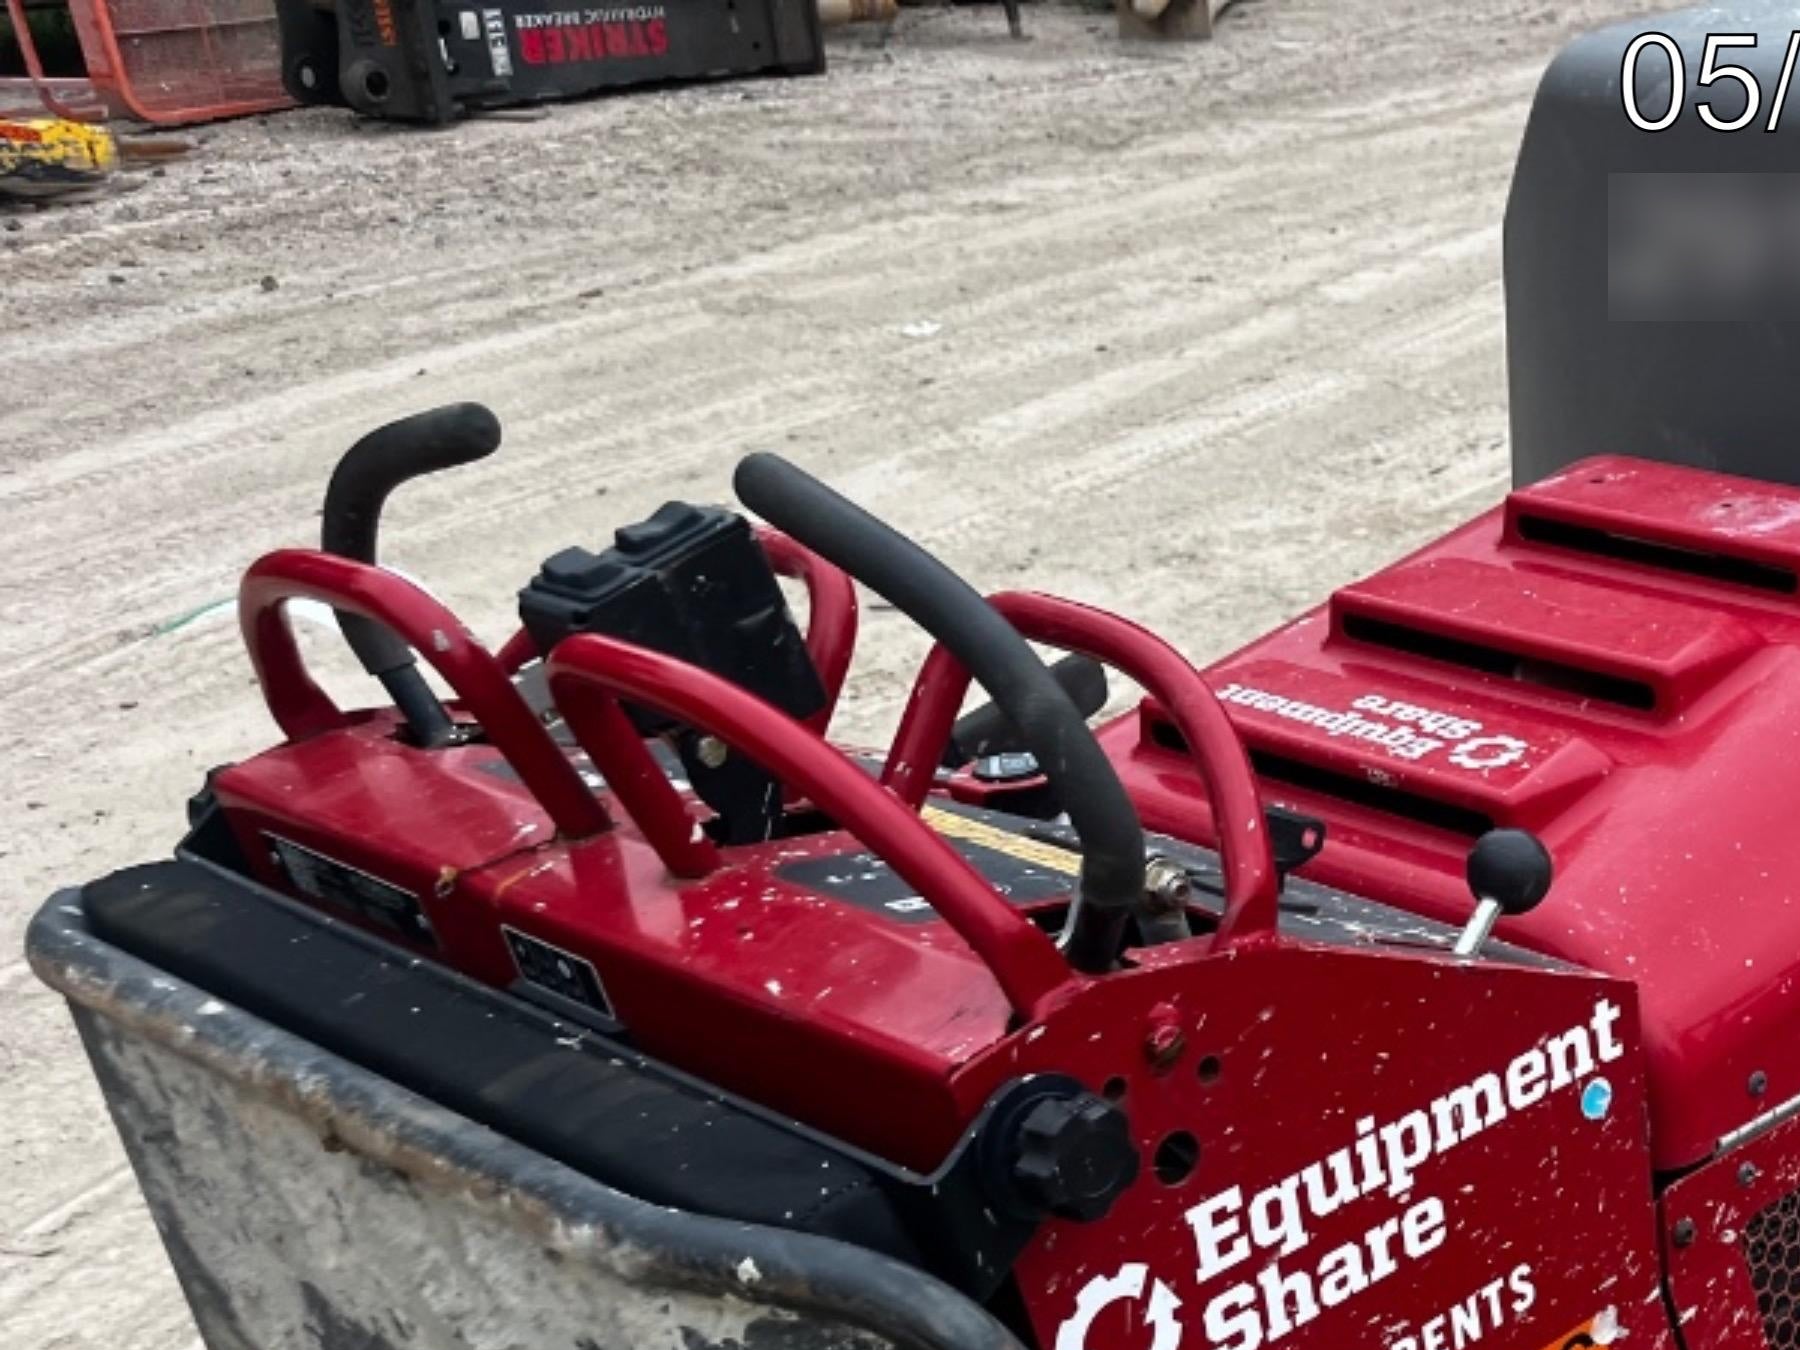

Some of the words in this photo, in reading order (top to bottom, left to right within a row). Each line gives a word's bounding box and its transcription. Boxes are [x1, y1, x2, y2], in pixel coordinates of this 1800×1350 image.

[513, 11, 581, 29] BREAKER
[519, 18, 670, 65] STRIKER
[1214, 683, 1444, 760] Equipment
[1353, 695, 1483, 739] Share
[1184, 997, 1624, 1284] Equipment
